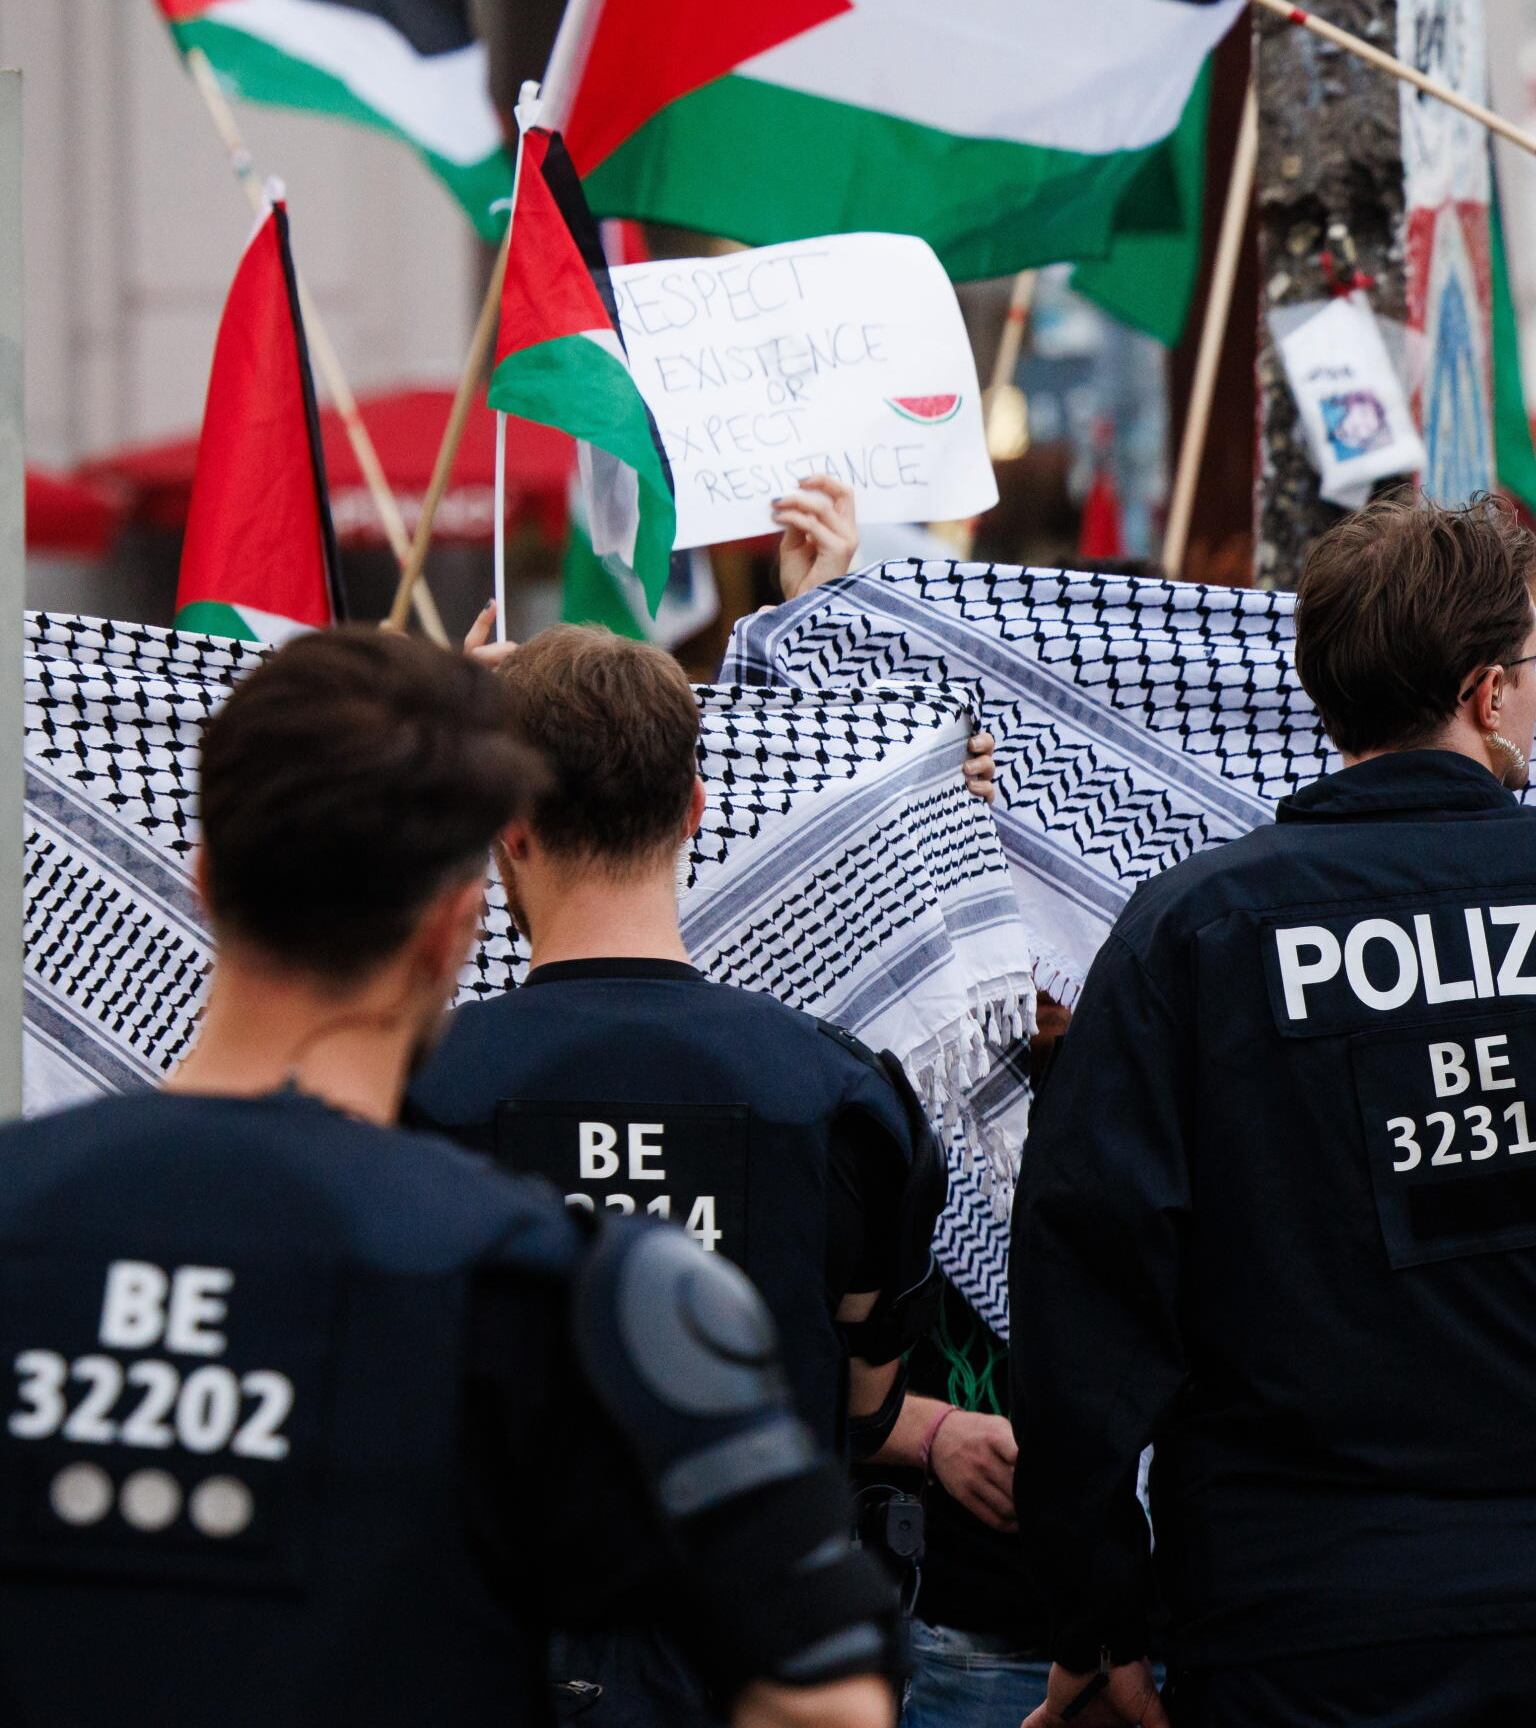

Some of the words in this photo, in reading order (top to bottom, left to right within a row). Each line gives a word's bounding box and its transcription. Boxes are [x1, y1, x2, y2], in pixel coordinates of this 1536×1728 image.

[655, 322, 888, 393] EXISTENCE
[766, 375, 809, 405] OR
[663, 407, 806, 463] XPECT
[1428, 1034, 1516, 1098] BE
[578, 1121, 666, 1180] BE
[99, 1260, 234, 1356] BE
[8, 1349, 294, 1460] 32202
